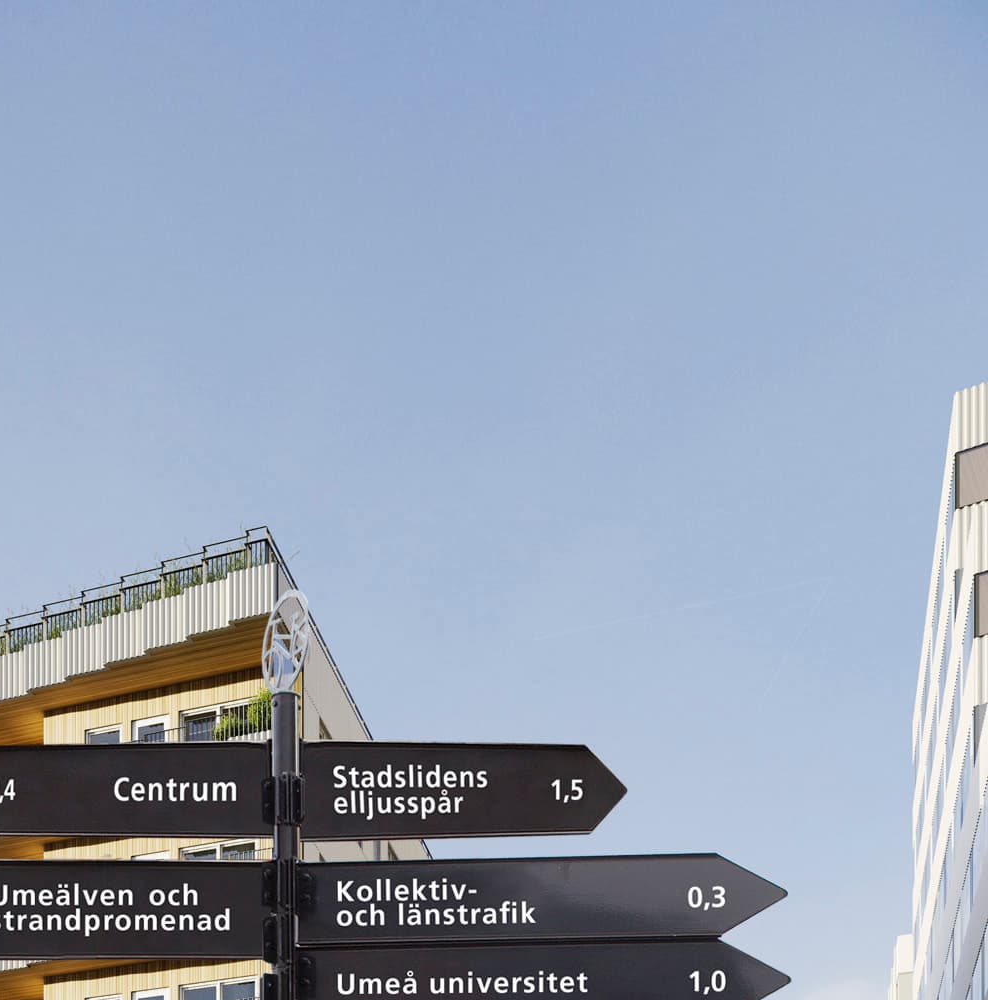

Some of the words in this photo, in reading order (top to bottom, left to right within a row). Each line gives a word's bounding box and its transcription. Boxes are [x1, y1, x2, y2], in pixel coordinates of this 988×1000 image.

[113, 776, 237, 802] Centrum
[332, 764, 488, 789] Stadslidens
[551, 779, 584, 804] 1,5
[333, 789, 464, 820] elljusspår
[149, 883, 198, 906] och
[337, 878, 477, 902] Kollektiv-
[687, 885, 726, 911] 0,3
[336, 903, 385, 927] och
[398, 902, 536, 926] länstrafik
[337, 970, 418, 995] Umeå
[430, 970, 588, 995] universitet
[689, 969, 727, 995] 1,0
